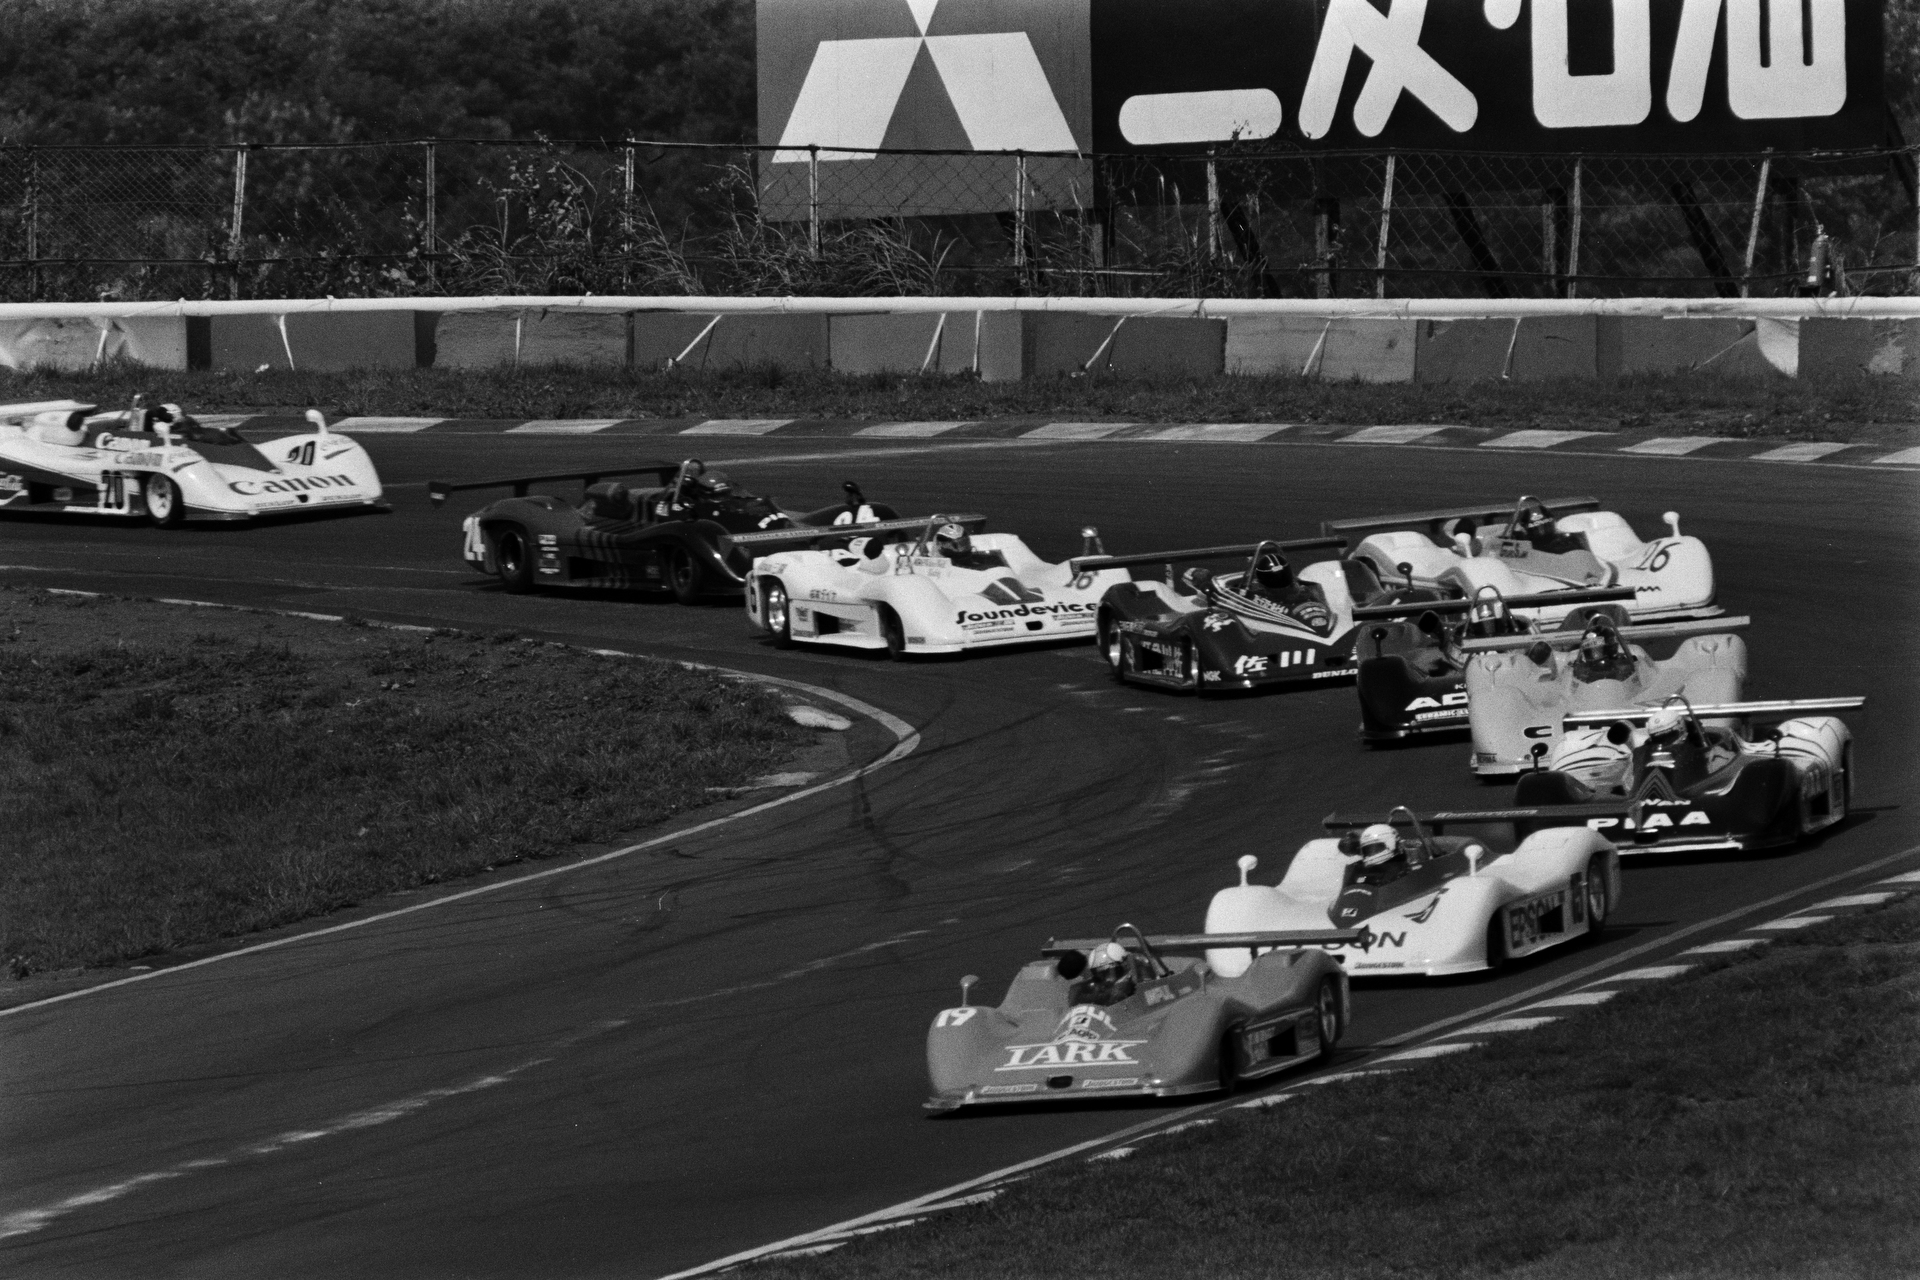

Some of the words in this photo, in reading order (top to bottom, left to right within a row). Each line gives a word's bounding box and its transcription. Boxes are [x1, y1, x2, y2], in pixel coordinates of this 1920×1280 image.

[228, 474, 356, 496] Canon
[1202, 670, 1222, 682] NGK
[1586, 811, 1711, 832] PIAA
[936, 1007, 978, 1028] 19
[1003, 1042, 1138, 1067] LARK
